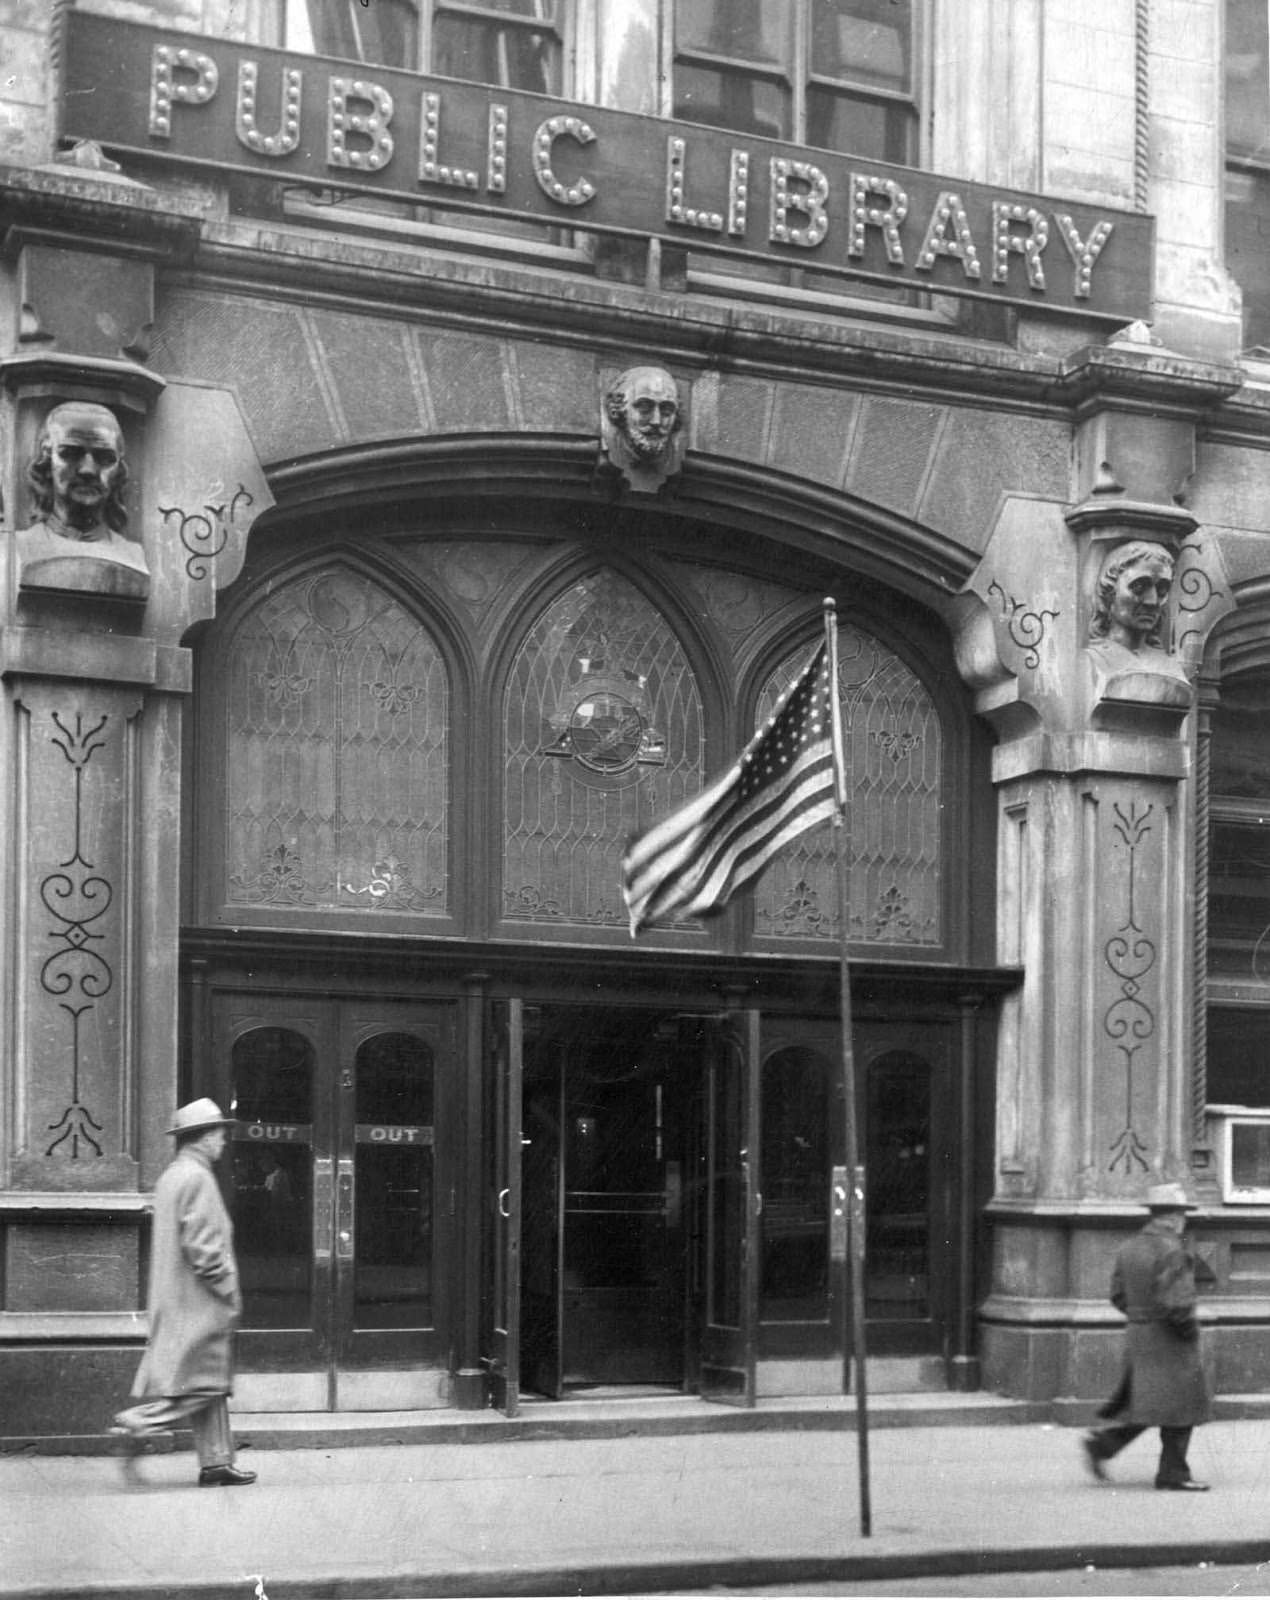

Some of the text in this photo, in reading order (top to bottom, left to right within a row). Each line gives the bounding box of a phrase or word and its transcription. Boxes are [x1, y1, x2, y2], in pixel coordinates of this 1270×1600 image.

[148, 43, 1114, 300] PUBLIC LIBRARY
[248, 1125, 298, 1140] OUT
[369, 1127, 419, 1142] OUT
